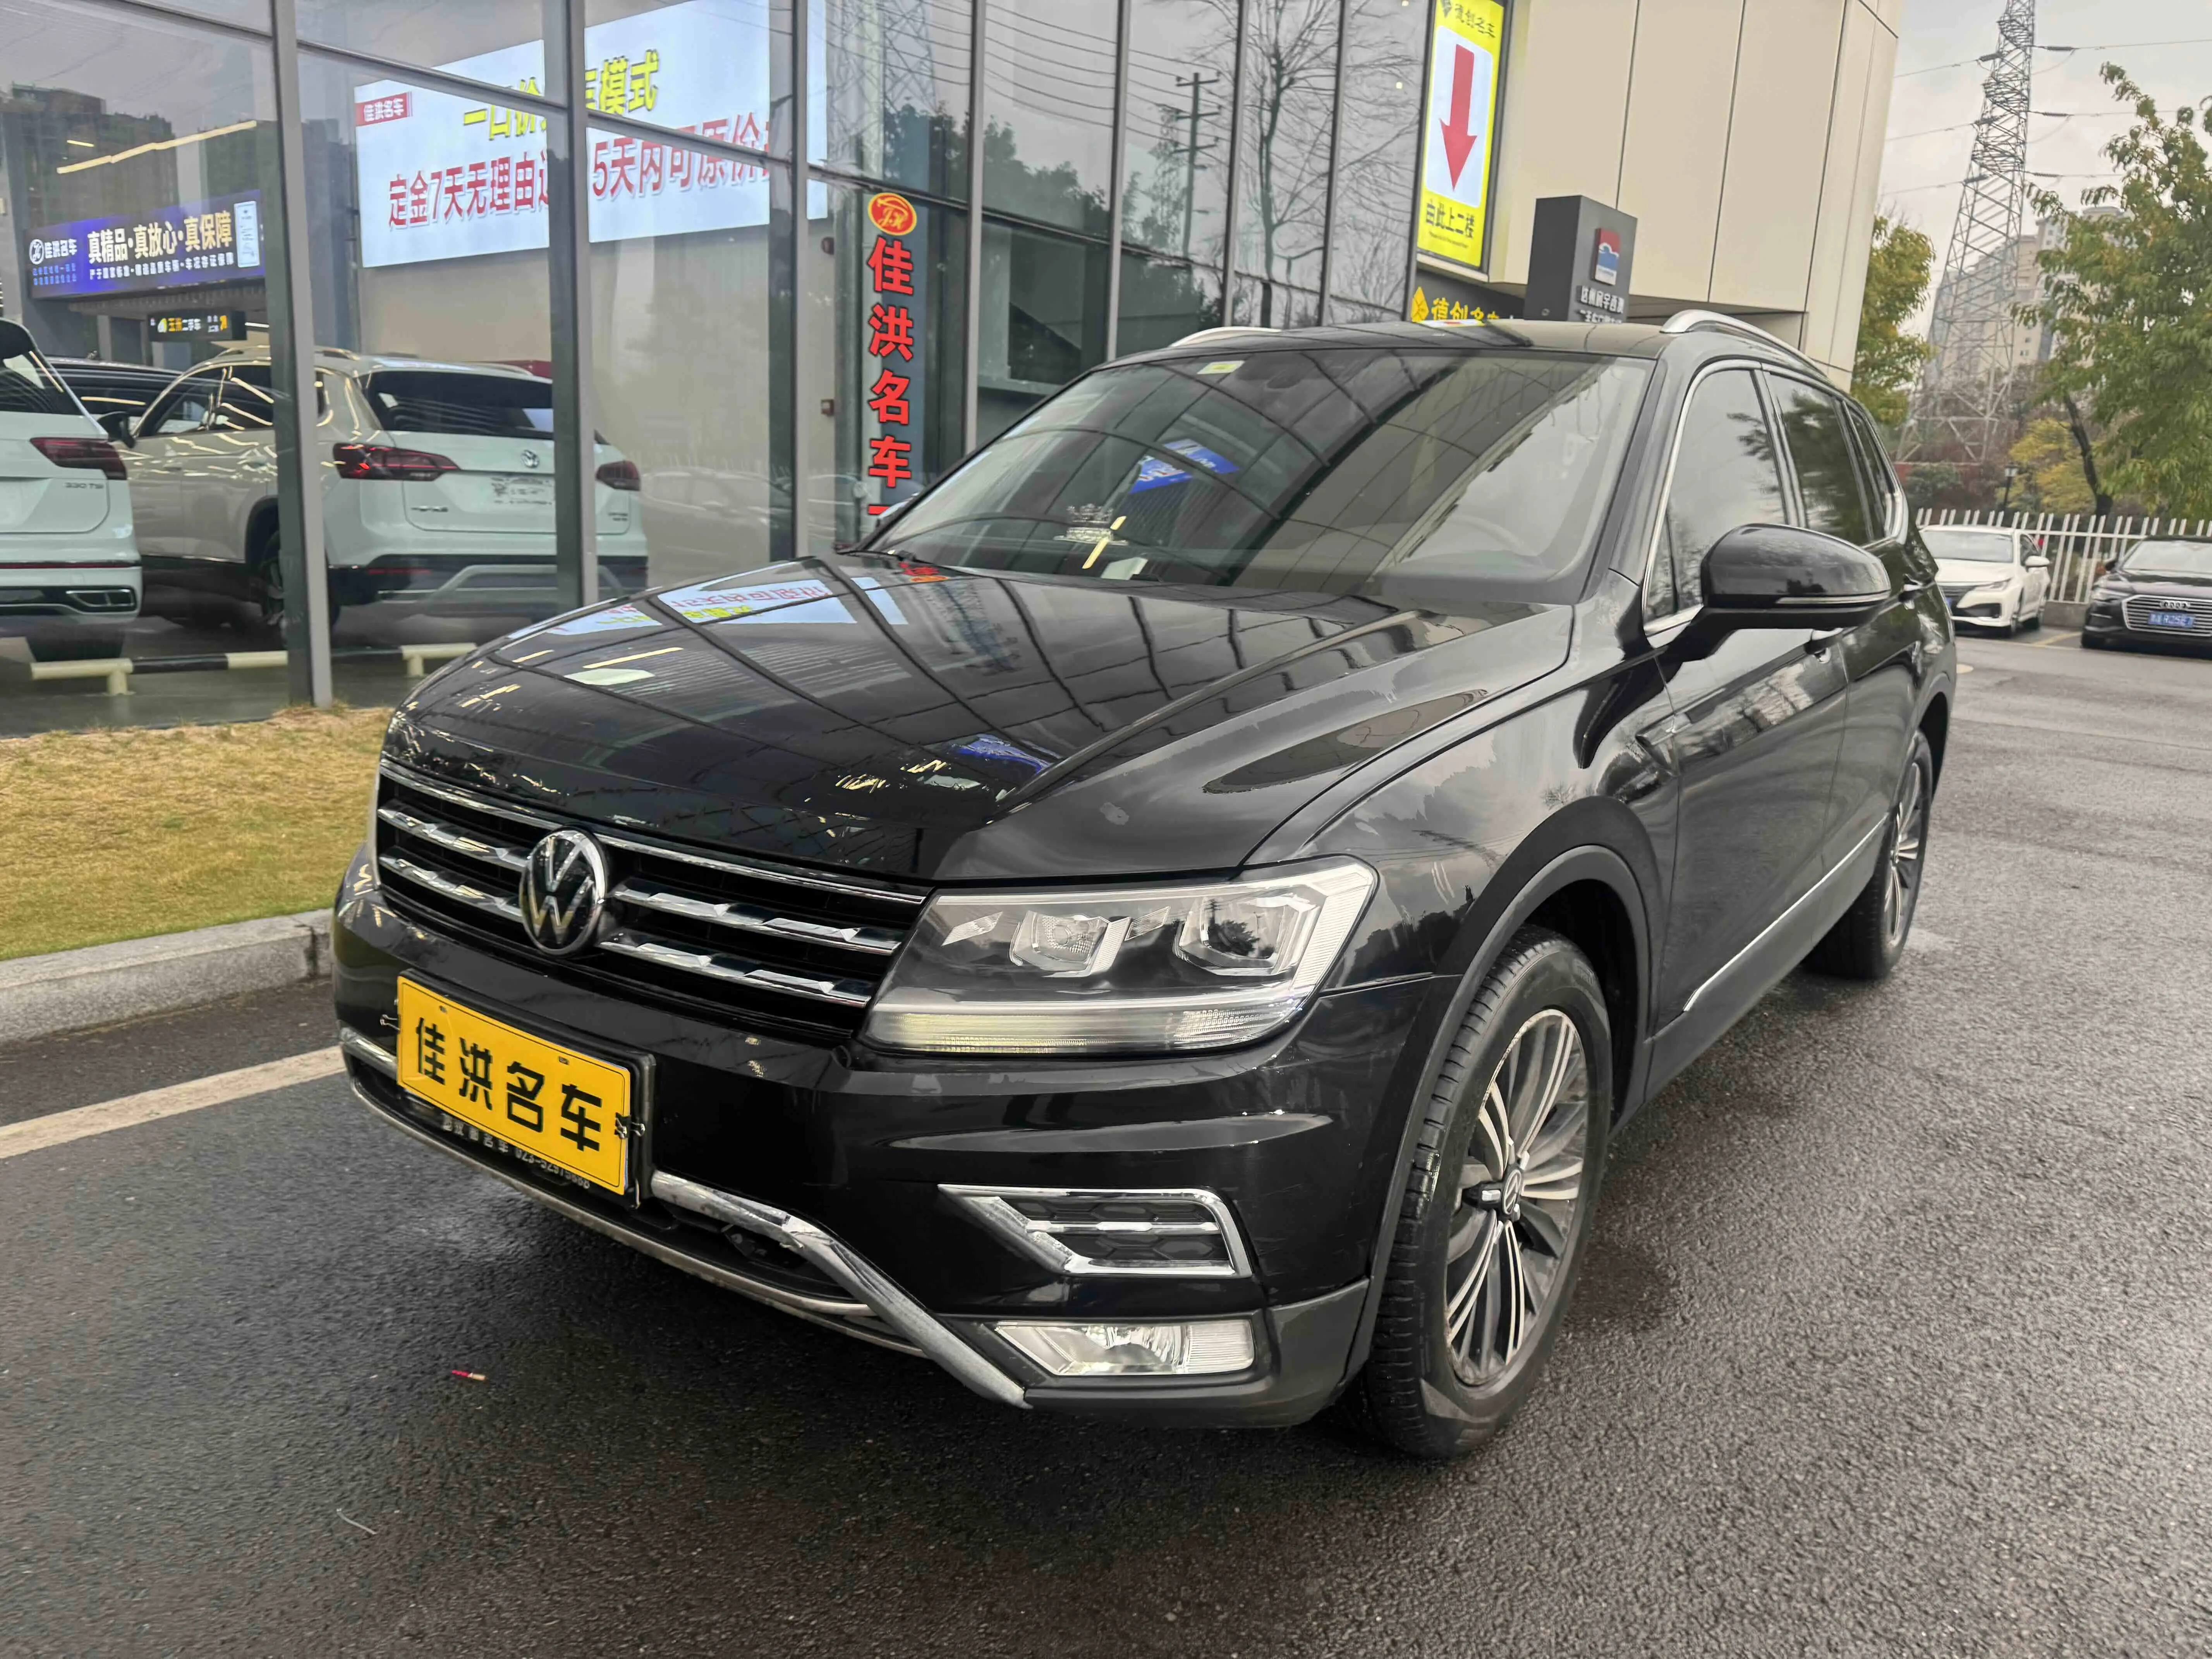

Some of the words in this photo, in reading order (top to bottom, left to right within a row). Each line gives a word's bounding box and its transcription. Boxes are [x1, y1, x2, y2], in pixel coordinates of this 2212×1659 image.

[364, 97, 404, 122] 佳洪名车
[867, 236, 914, 516] 佳洪名车
[415, 1017, 603, 1152] 佳洪名车
